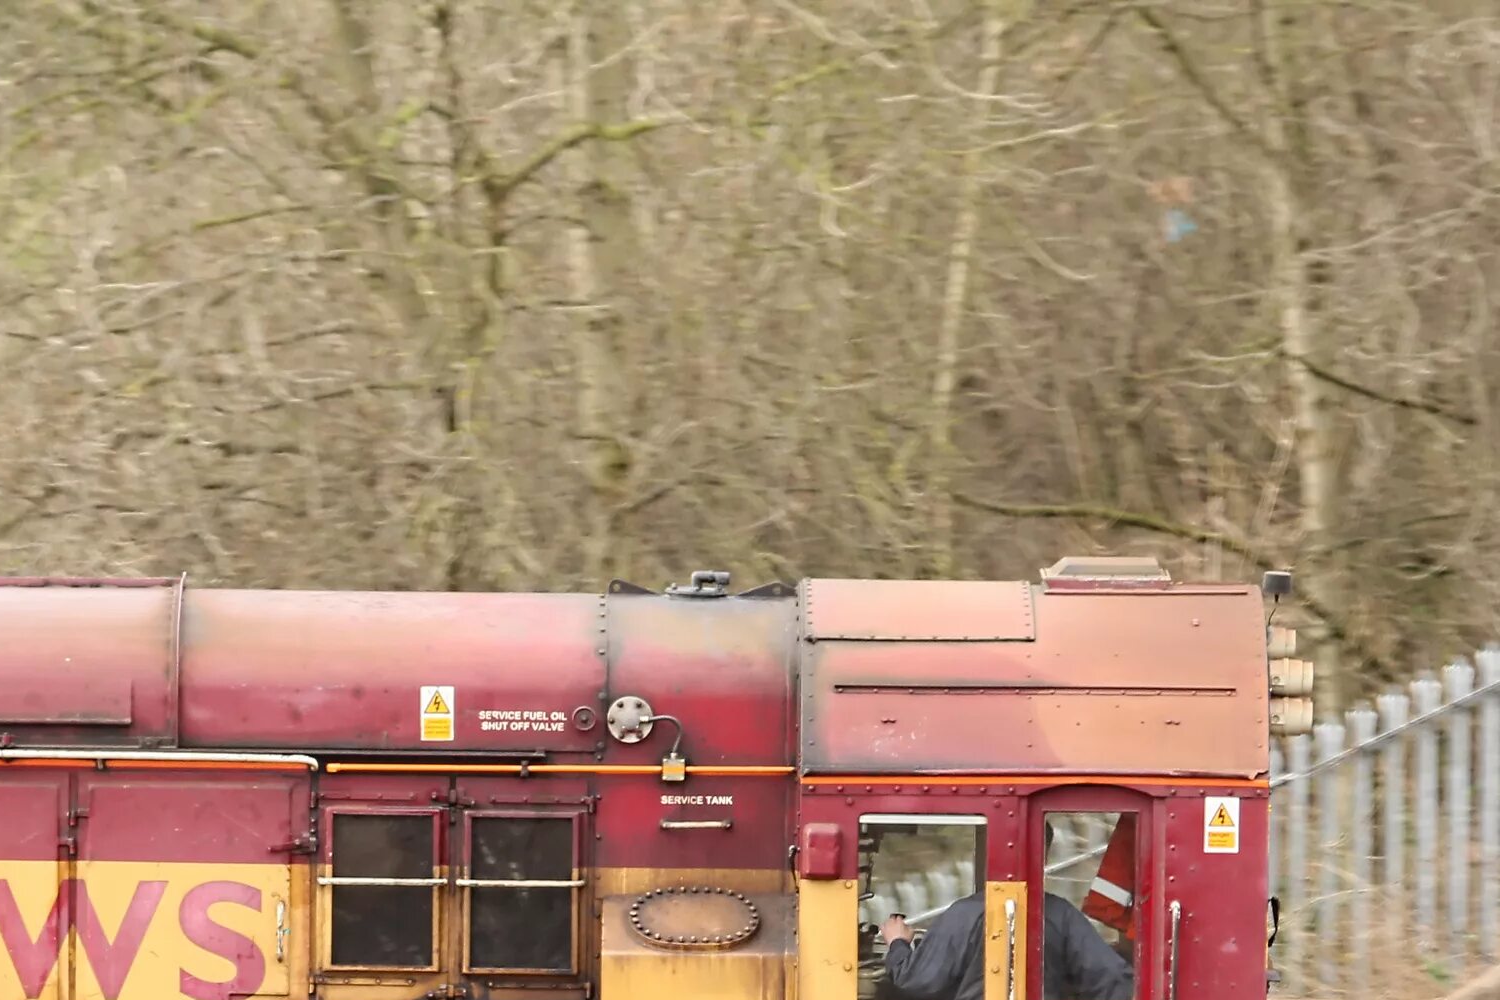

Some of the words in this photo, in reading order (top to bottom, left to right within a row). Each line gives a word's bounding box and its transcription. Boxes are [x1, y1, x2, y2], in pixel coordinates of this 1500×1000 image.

[479, 711, 521, 720] SERVICE
[523, 711, 548, 721] FUEL
[551, 712, 567, 721] OIL
[481, 721, 508, 731] SHUT
[510, 722, 530, 731] OFF
[532, 722, 564, 731] VALVE
[661, 795, 703, 805] SERVICE
[705, 796, 733, 805] TANK
